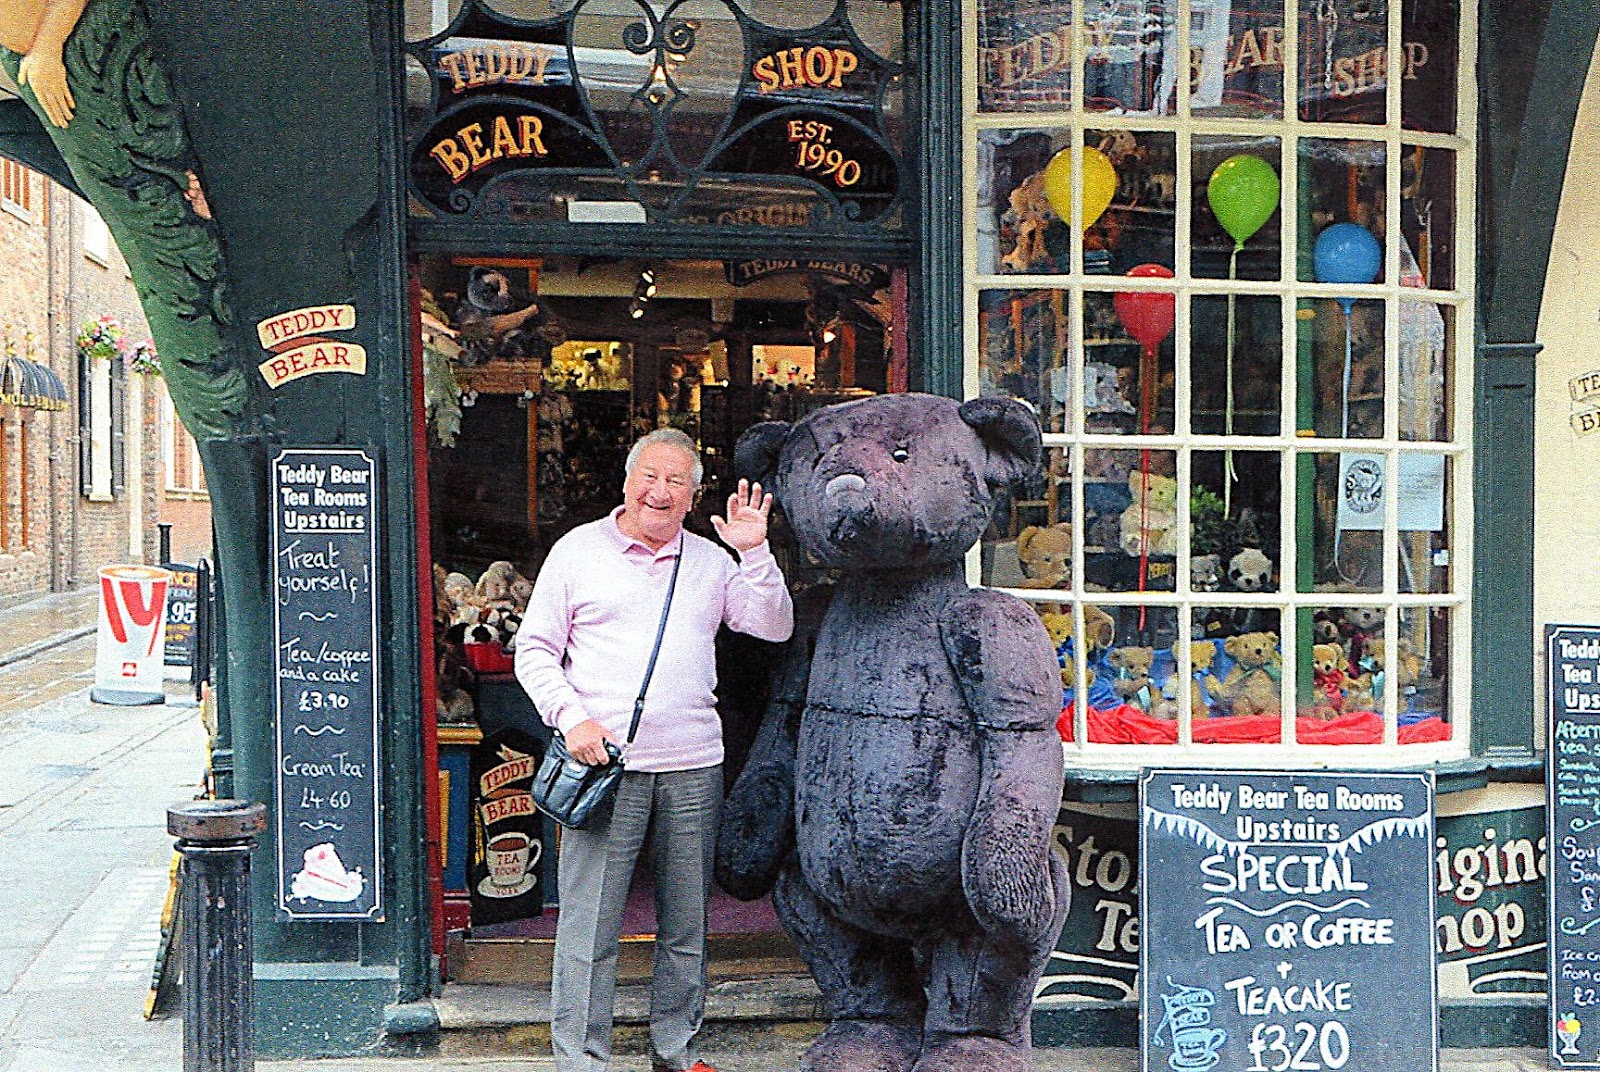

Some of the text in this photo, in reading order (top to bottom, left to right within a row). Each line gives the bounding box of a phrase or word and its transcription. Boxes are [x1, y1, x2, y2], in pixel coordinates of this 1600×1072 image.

[439, 46, 551, 92] TEDDY
[753, 46, 858, 95] SHOP
[787, 120, 833, 144] EST.
[430, 115, 548, 184] BEAR
[795, 142, 861, 188] 1990
[265, 309, 343, 340] TEDDY
[269, 346, 351, 381] BEAR
[278, 464, 370, 487] Teddy Bear
[280, 487, 368, 507] Tea Rooms
[284, 510, 366, 532] Upstairs
[279, 539, 341, 570] Treat
[1558, 638, 1600, 661] Tedd
[322, 668, 360, 683] cake
[1561, 663, 1592, 683] Tea
[283, 755, 336, 777] Cream
[483, 760, 530, 788] TEDDY
[486, 797, 530, 820] BEAR
[1171, 783, 1404, 814] Teddy Bear Tea Rooms
[1236, 816, 1340, 843] Upstairs
[497, 853, 519, 864] TEA
[1200, 854, 1368, 894] SPECIAL
[1194, 906, 1394, 955] TEA OR COFFEE
[1224, 976, 1351, 1016] TEACAKE
